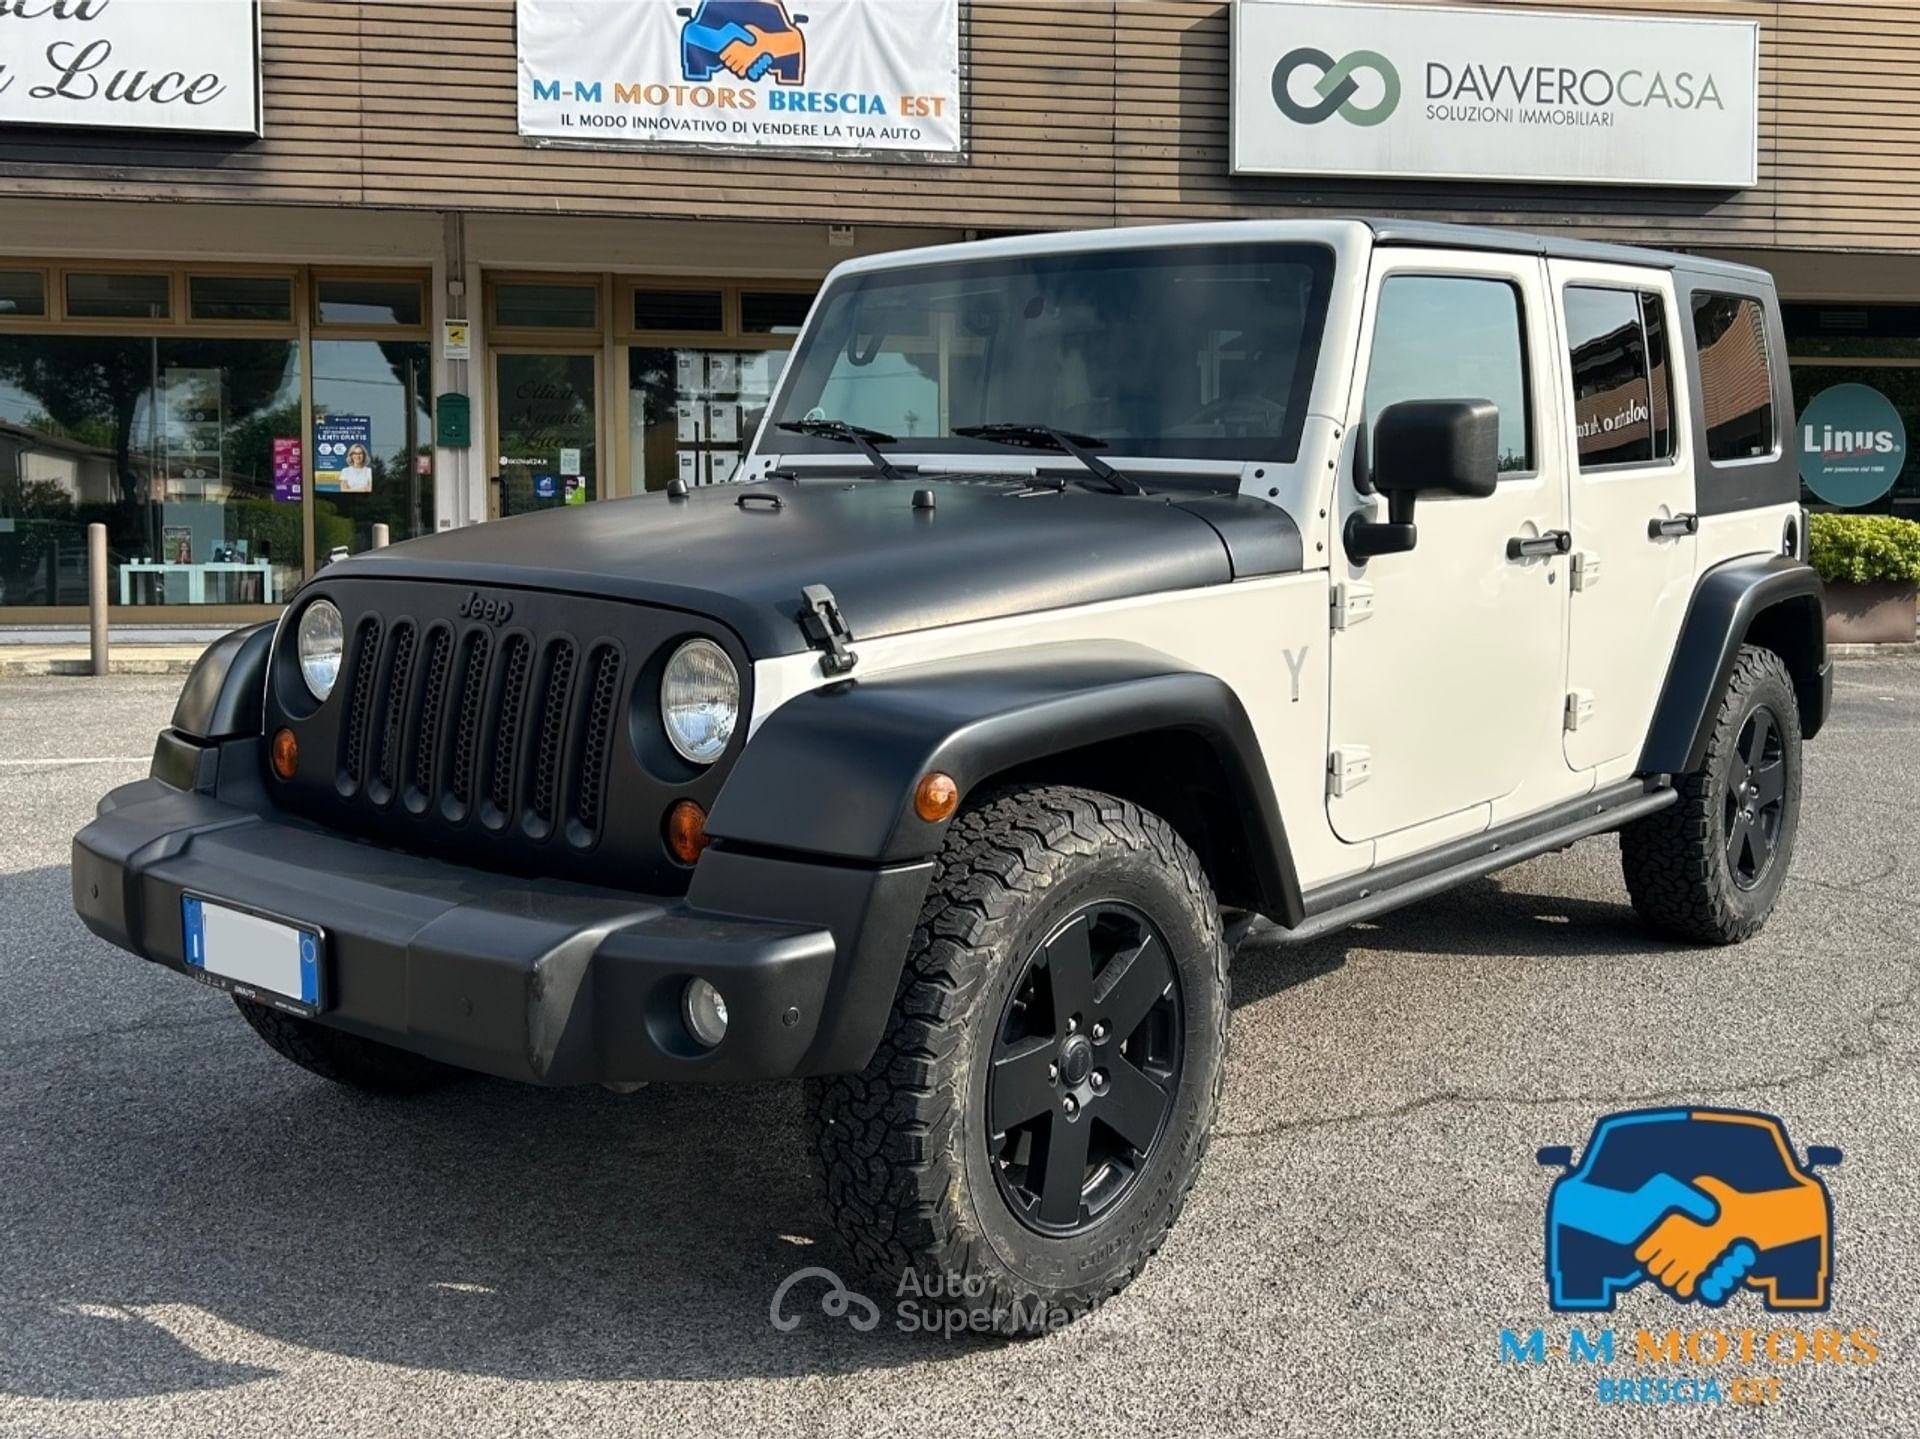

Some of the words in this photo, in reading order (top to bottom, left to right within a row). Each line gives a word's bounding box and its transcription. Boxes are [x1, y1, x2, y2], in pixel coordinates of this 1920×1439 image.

[28, 39, 227, 105] Luce
[1425, 61, 1725, 111] DAVVEROCASA
[532, 79, 602, 103] M-M
[613, 82, 757, 110] MOTORS
[768, 89, 887, 116] BRESCIA
[899, 95, 947, 117] EST
[1425, 104, 1514, 124] SOLUZIONI
[1518, 108, 1615, 128] IMMOBILIARI
[560, 113, 574, 126] IL
[579, 114, 628, 129] MODO
[632, 116, 728, 133] INNOVATIVO
[732, 121, 747, 134] DI
[752, 122, 819, 137] VENDERE
[823, 125, 842, 137] LA
[846, 125, 877, 139] TUA
[879, 127, 921, 141] AUTO
[1804, 424, 1894, 453] Linus
[457, 591, 514, 628] Jeep
